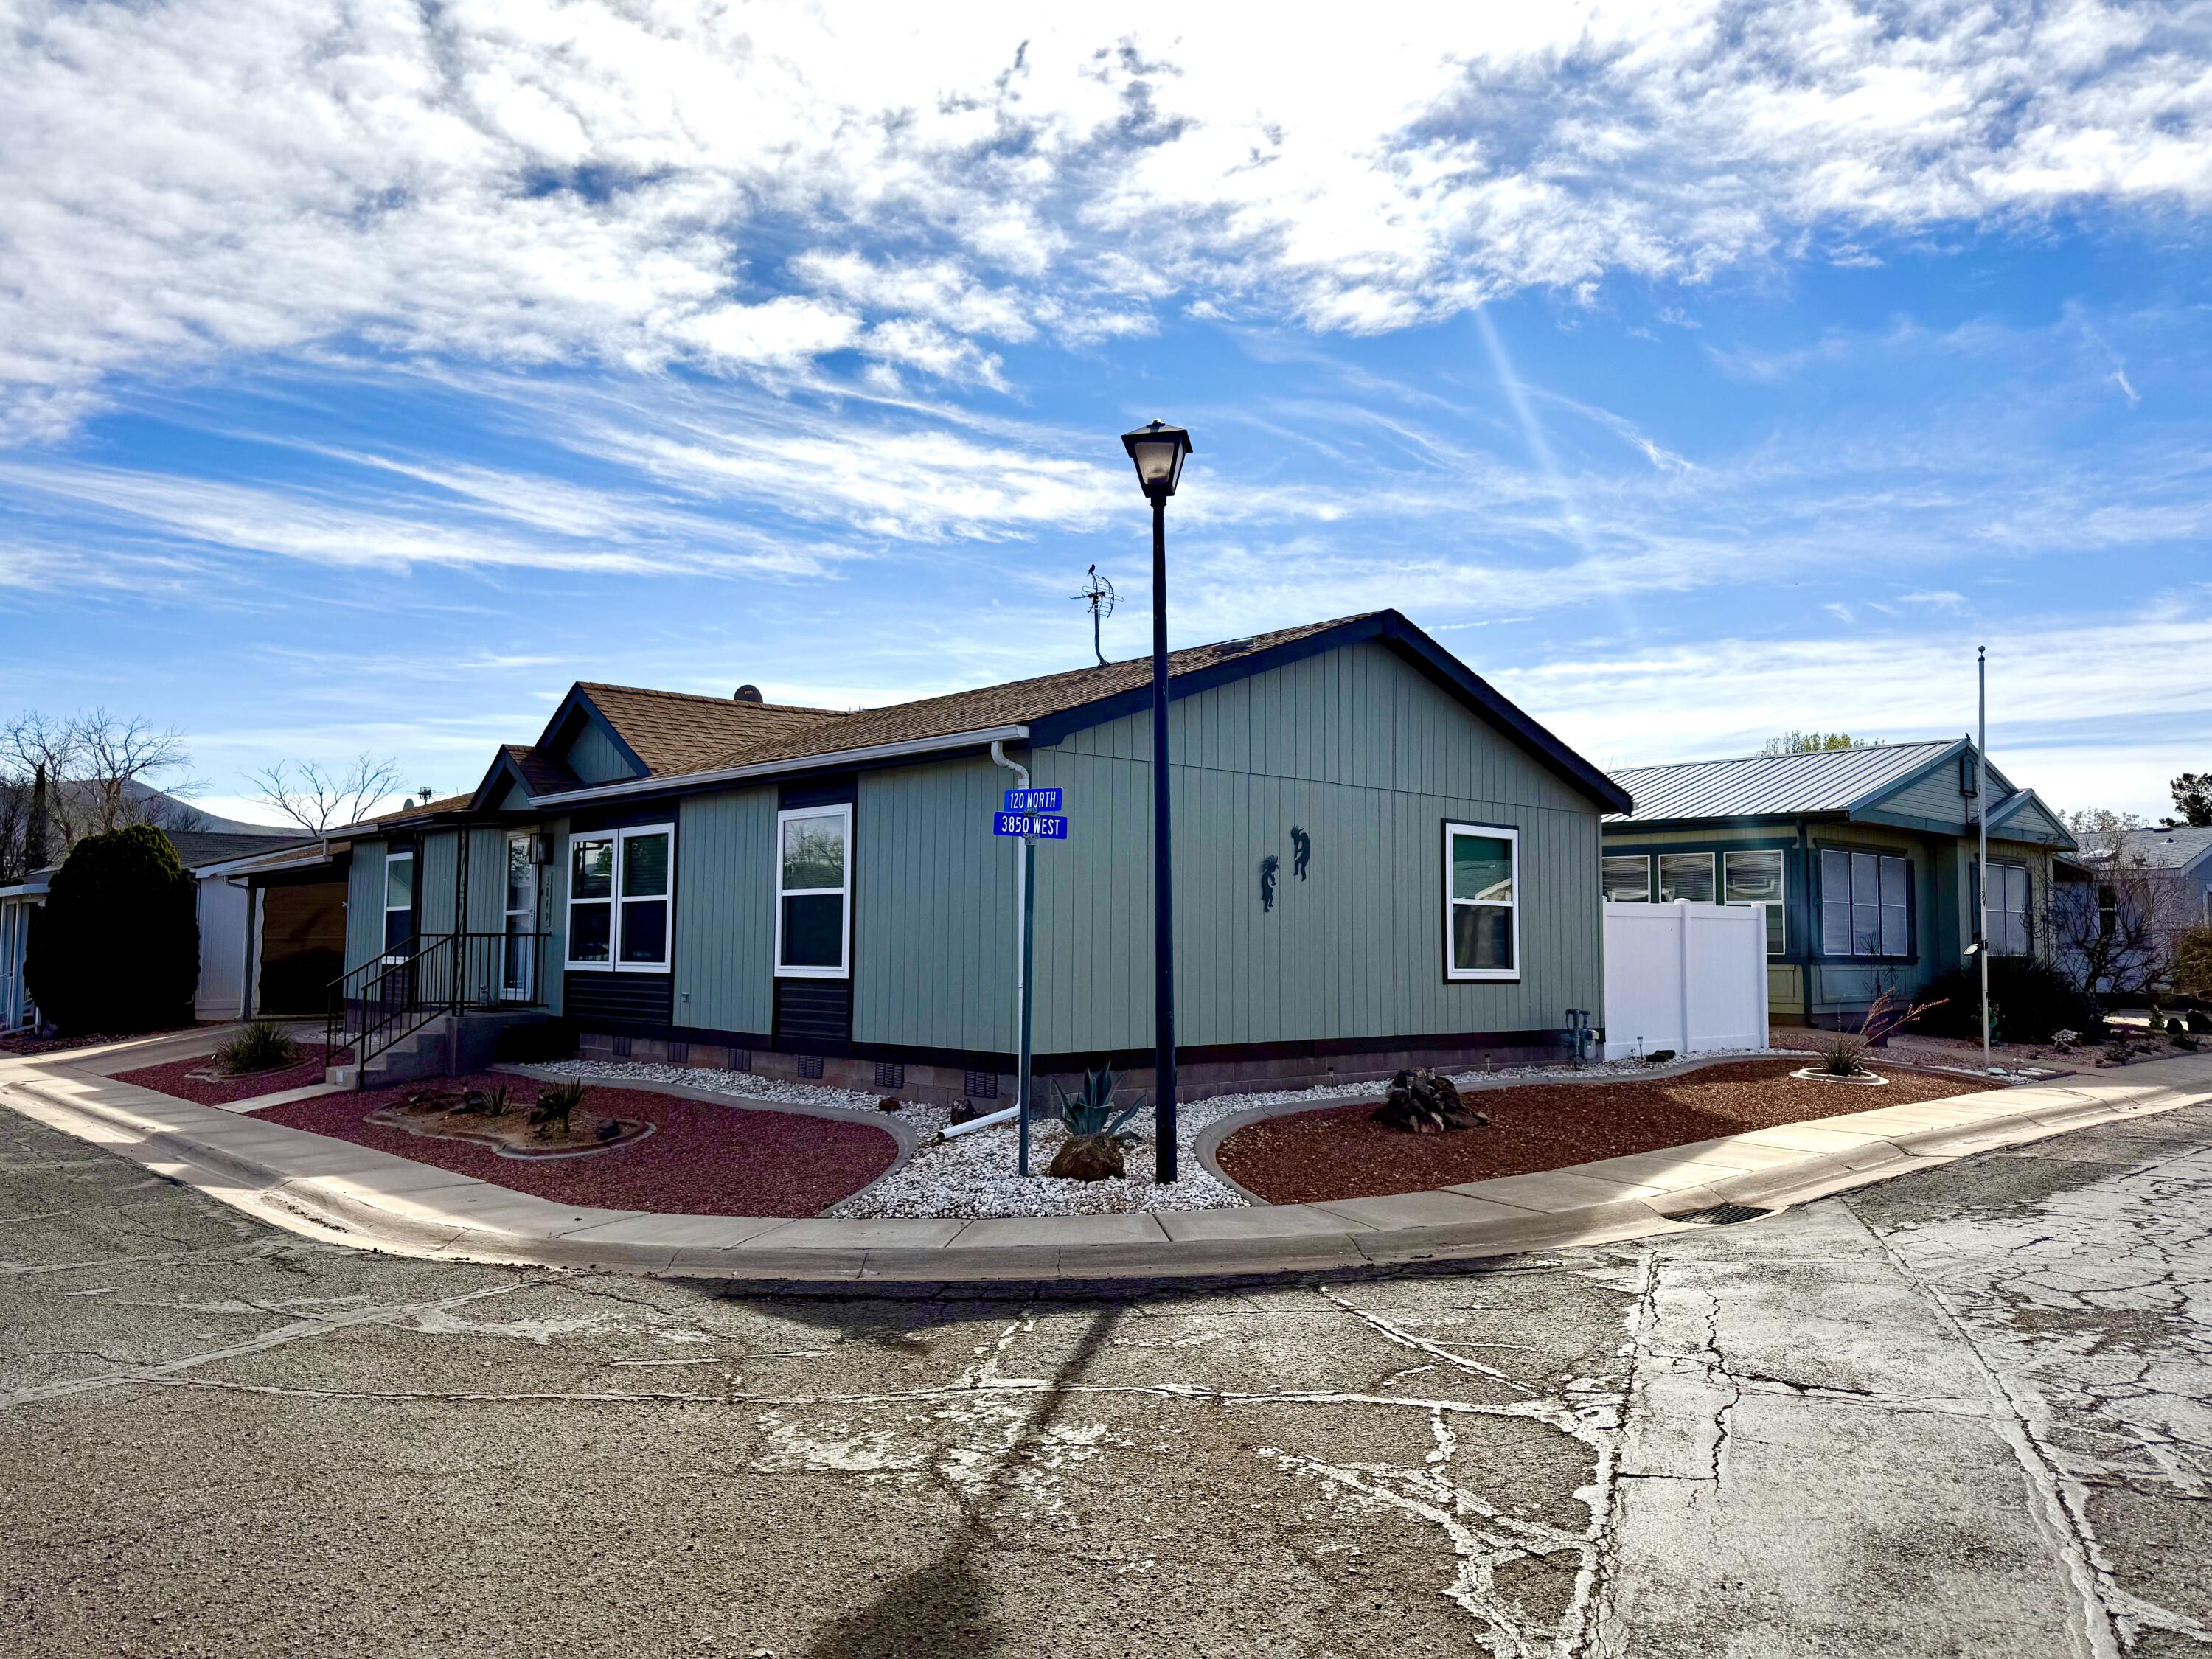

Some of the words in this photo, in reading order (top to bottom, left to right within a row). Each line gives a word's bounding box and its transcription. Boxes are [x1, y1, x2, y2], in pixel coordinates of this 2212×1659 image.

[1010, 793, 1024, 809] 120
[1027, 791, 1056, 808] NORTH
[1001, 815, 1029, 833] 3850
[1033, 818, 1060, 835] WEST
